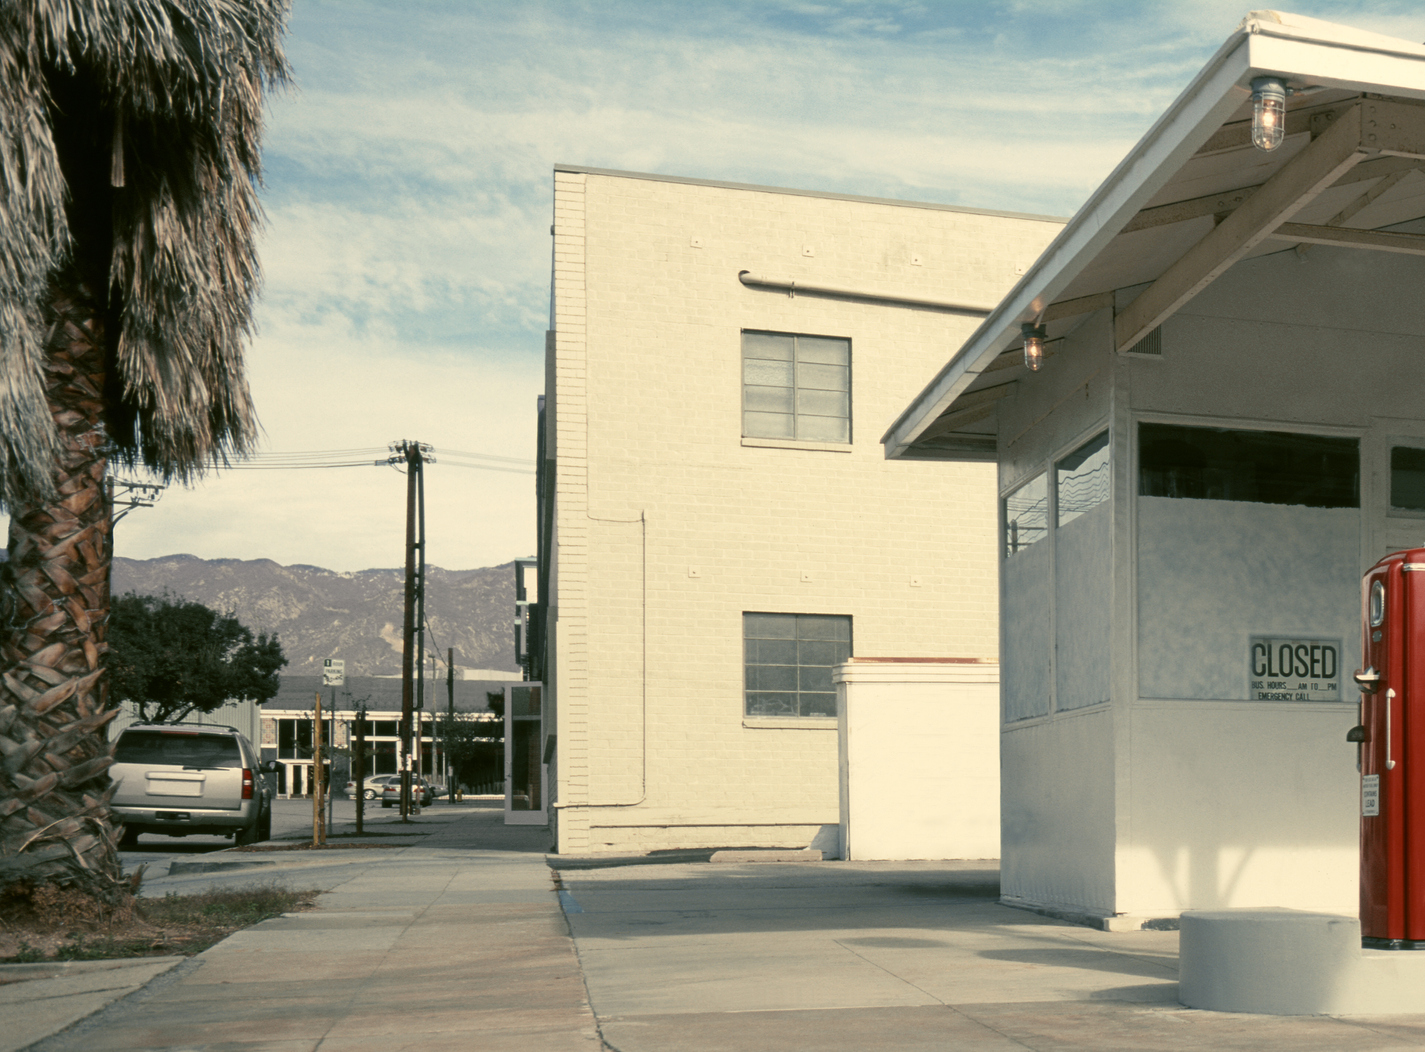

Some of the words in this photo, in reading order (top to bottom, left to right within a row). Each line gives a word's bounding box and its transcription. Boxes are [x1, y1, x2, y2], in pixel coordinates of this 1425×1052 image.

[1251, 643, 1337, 679] CLOSED
[1251, 681, 1264, 690] BUS.
[1267, 682, 1287, 690] HOURS
[1298, 683, 1307, 691] AM
[1311, 683, 1318, 691] TO
[1328, 683, 1337, 691] PM
[1258, 692, 1293, 701] EMERGENCY
[1295, 693, 1310, 701] CALL
